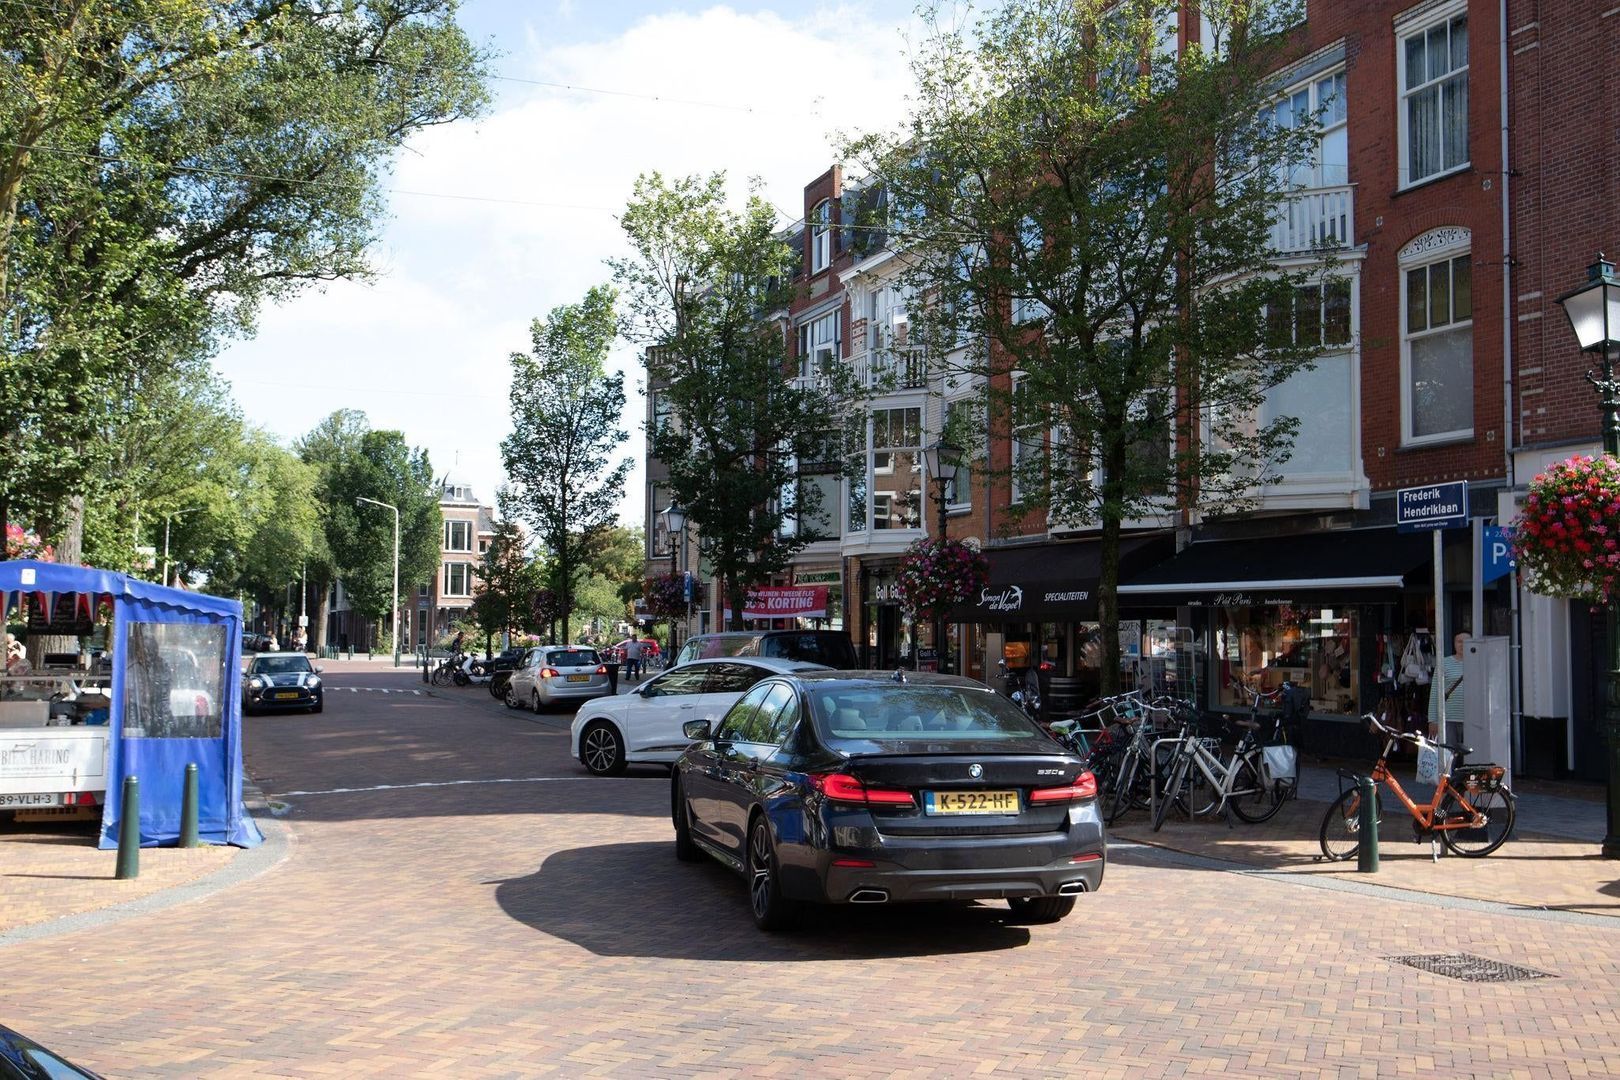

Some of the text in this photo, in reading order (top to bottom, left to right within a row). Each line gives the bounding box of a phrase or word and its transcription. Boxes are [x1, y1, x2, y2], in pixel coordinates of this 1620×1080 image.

[1404, 488, 1440, 502] Frederik
[1404, 503, 1458, 518] Hendriklaan
[1493, 543, 1507, 565] P
[875, 584, 888, 600] Gall
[976, 588, 1001, 606] Simon
[1044, 592, 1088, 602] SPECIALITEITEN
[767, 597, 813, 609] KORTING
[941, 792, 1013, 809] K-522-HF
